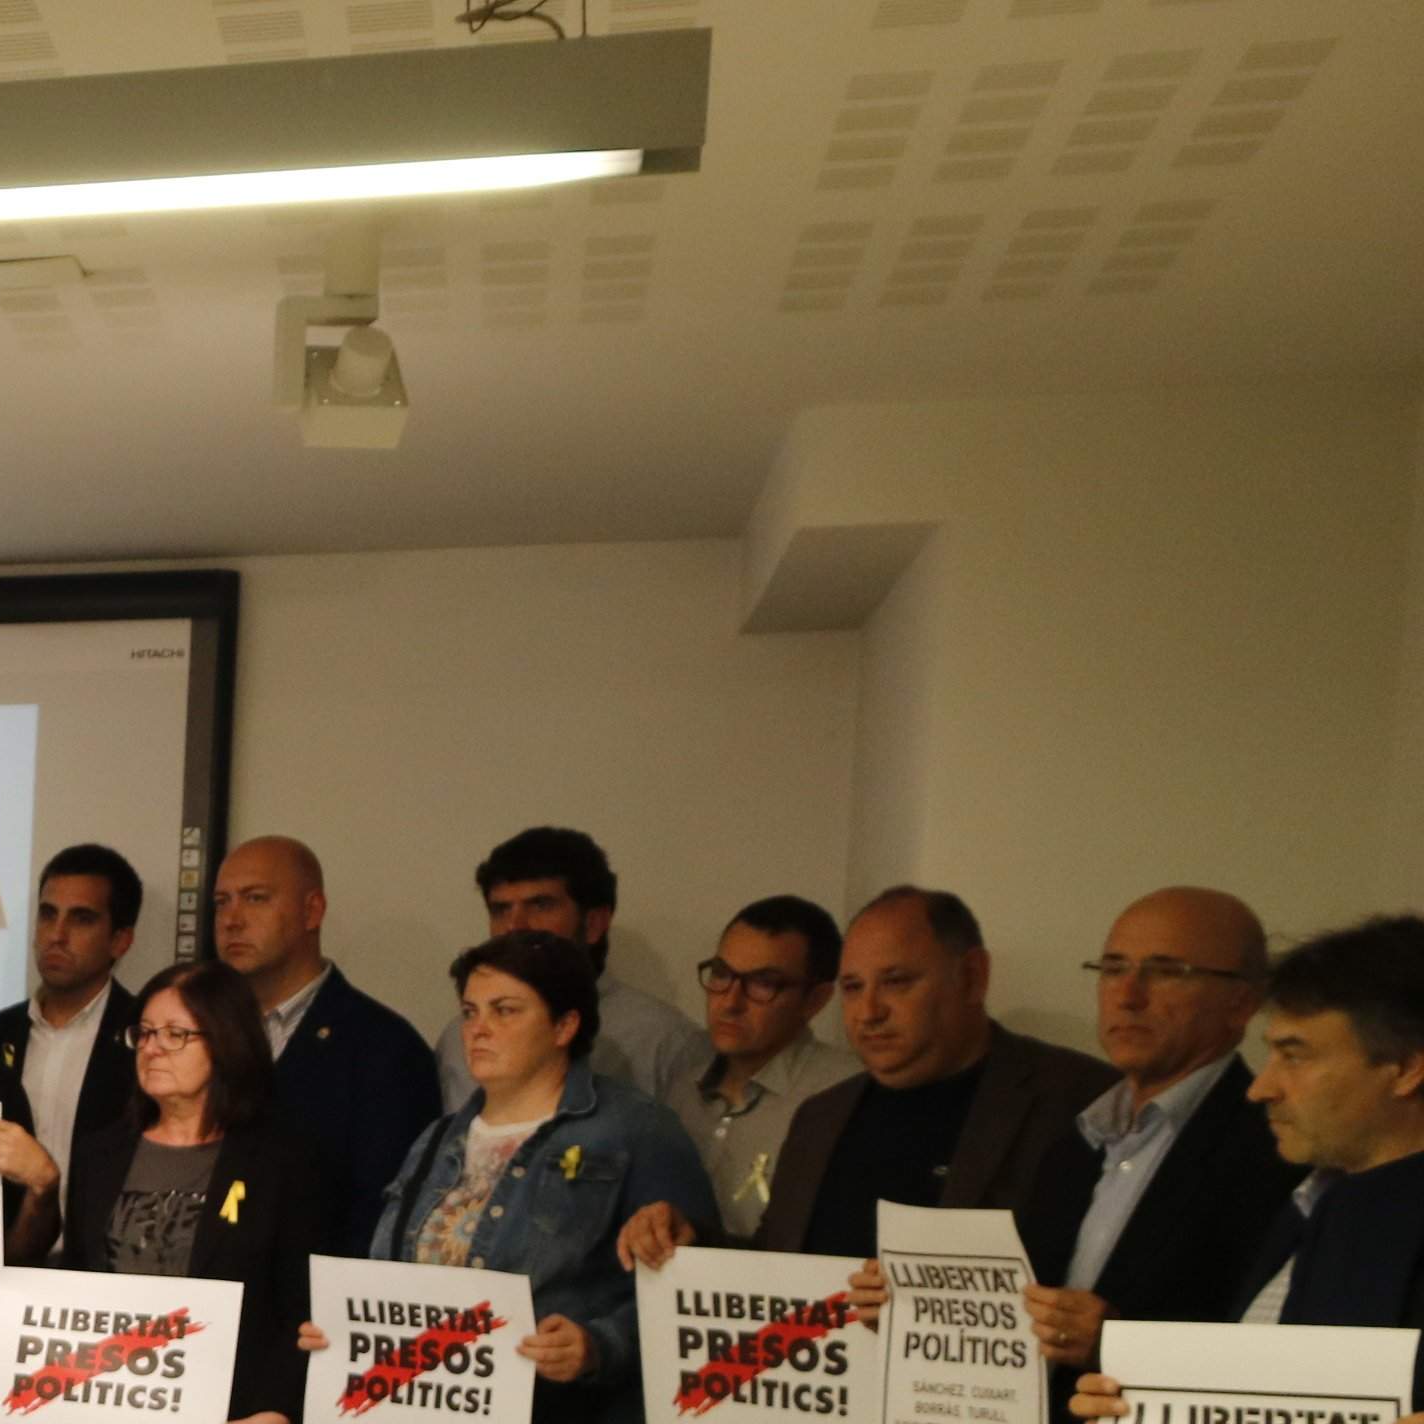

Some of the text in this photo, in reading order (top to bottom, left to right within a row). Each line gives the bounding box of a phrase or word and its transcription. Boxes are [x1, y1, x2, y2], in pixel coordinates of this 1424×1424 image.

[890, 1262, 1020, 1294] LLIBERTAT
[22, 1305, 191, 1340] LLIBERTAT
[346, 1297, 495, 1335] LLIBERTAT
[675, 1289, 850, 1330] LLIBERTAT
[913, 1296, 1018, 1330] PRESOS
[15, 1334, 186, 1379] PRESOS
[349, 1332, 495, 1378] PRESOS
[678, 1326, 849, 1376] PRESOS
[904, 1328, 1027, 1369] POLÍTICS
